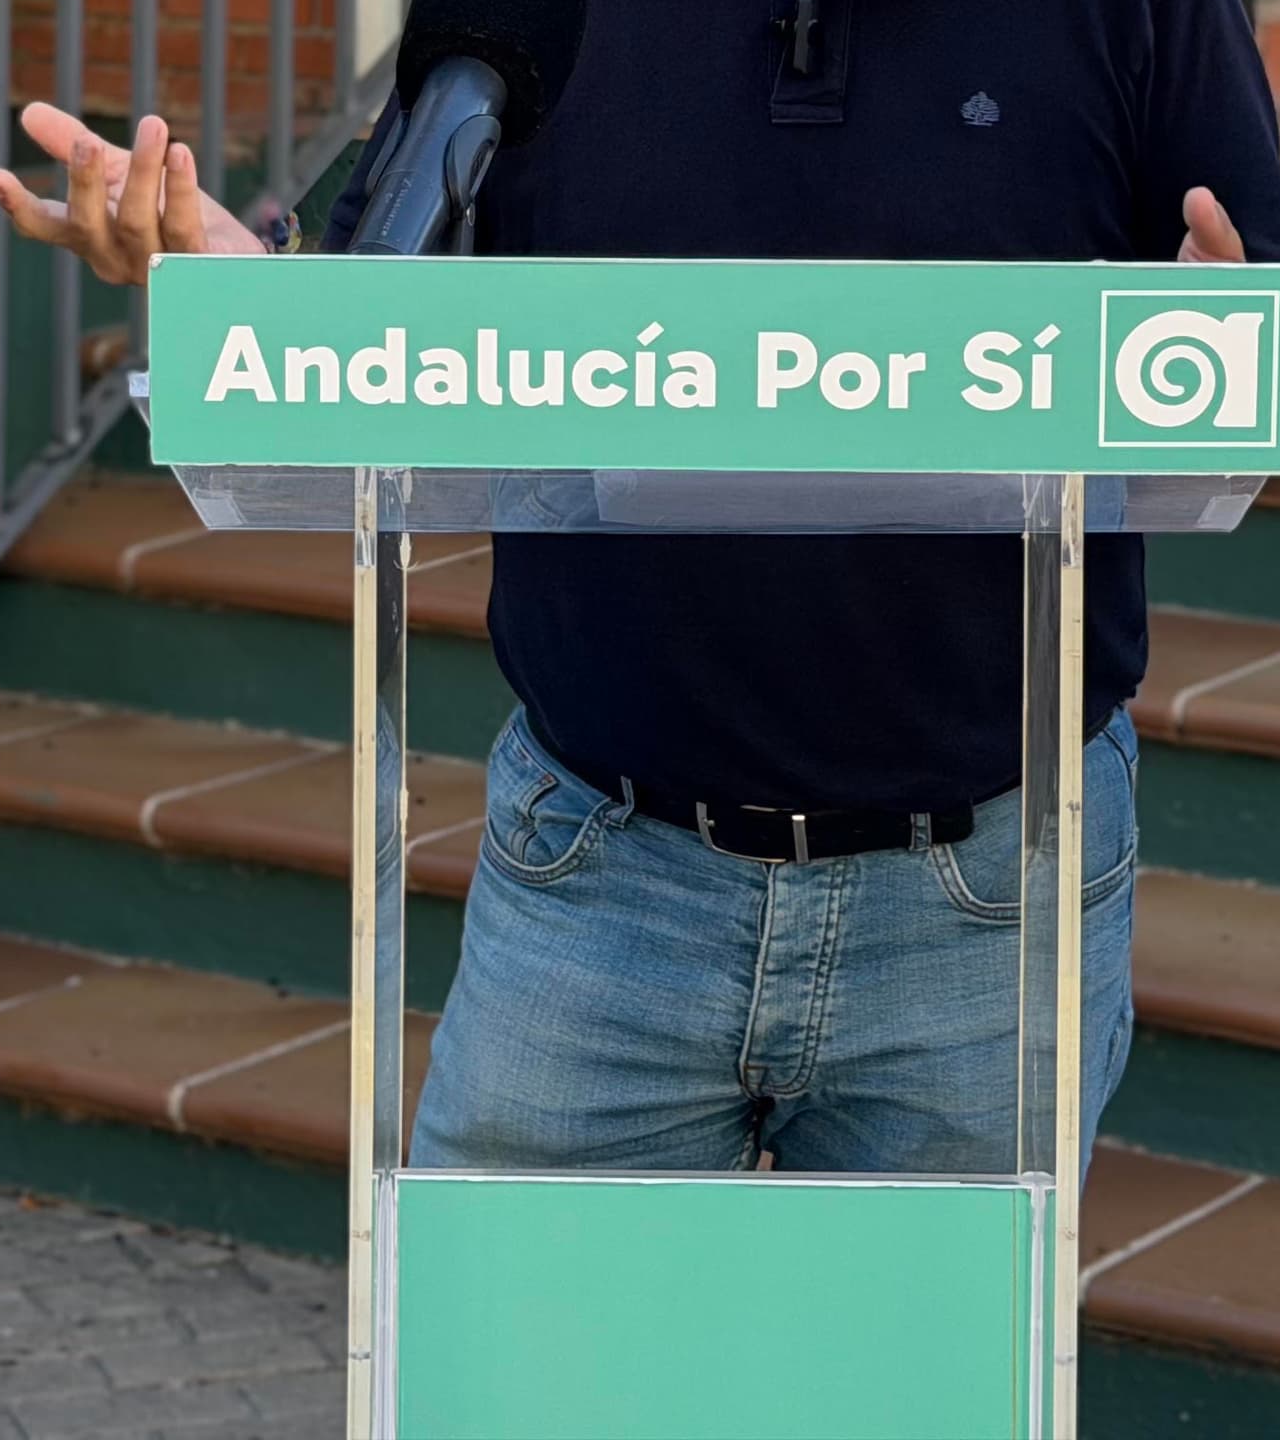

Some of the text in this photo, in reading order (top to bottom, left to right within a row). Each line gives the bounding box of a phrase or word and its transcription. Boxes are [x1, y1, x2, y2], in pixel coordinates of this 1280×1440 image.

[203, 321, 717, 409] Andalucía
[756, 330, 927, 410] Por
[960, 323, 1062, 411] Sí
